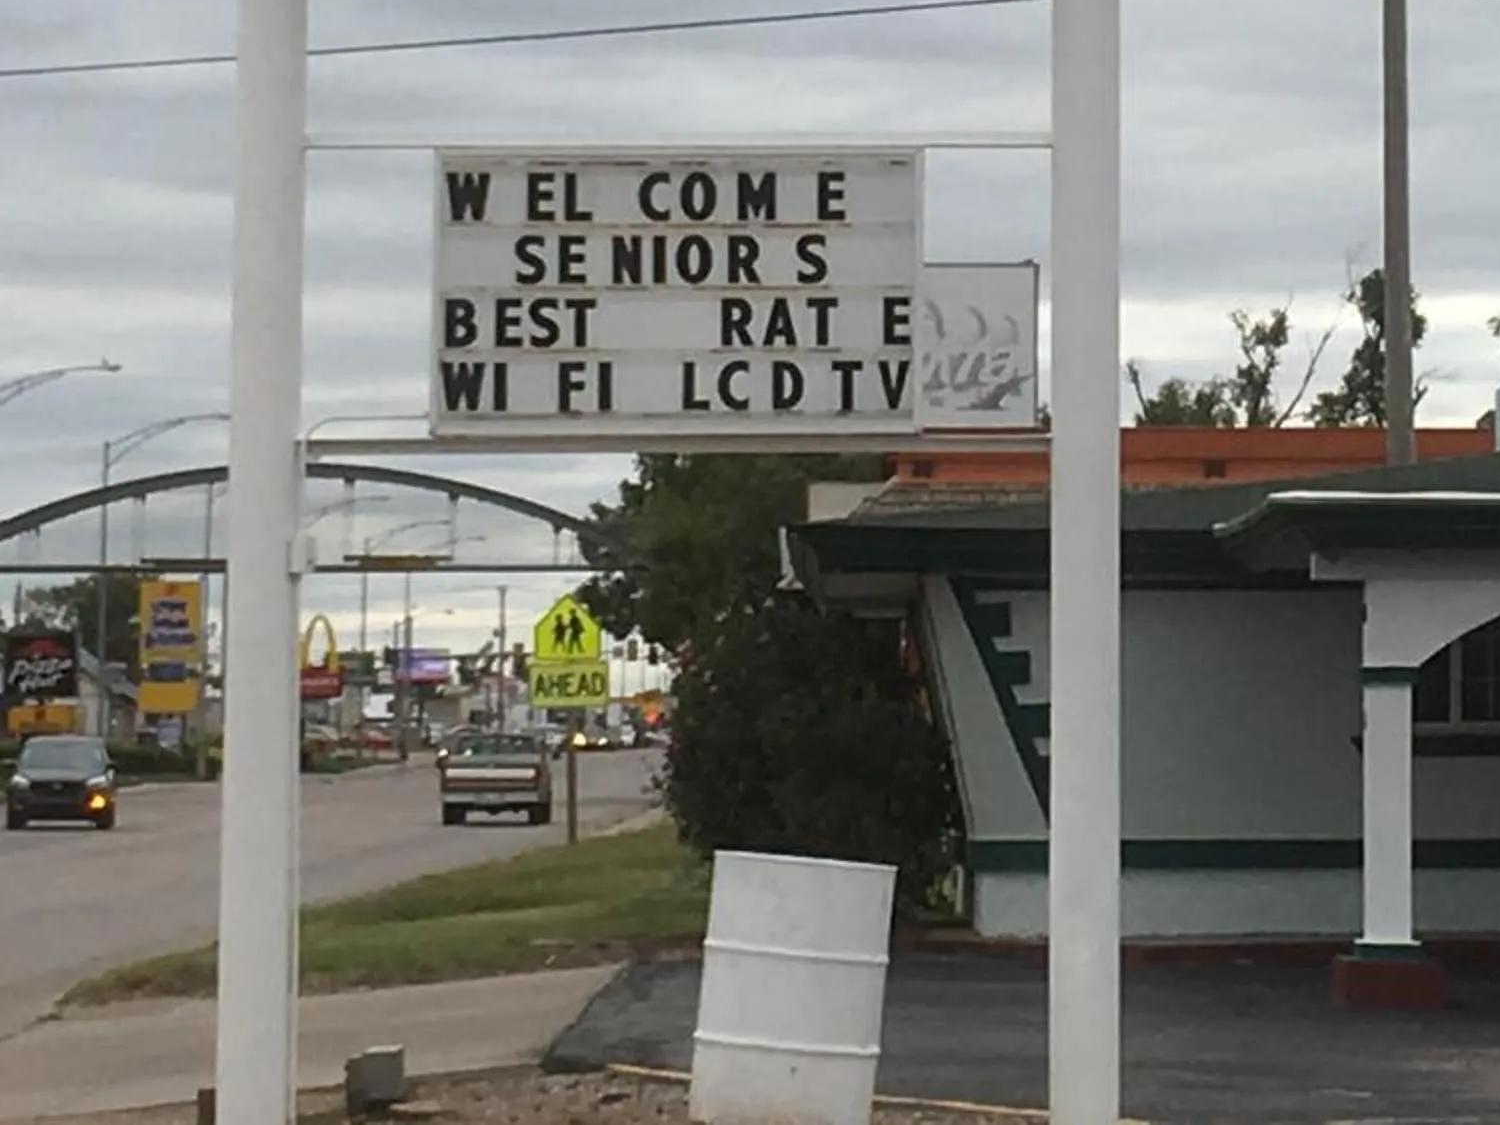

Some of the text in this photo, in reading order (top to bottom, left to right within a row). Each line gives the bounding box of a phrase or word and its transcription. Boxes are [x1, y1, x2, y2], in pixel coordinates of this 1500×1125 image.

[445, 170, 847, 222] WELCOME
[514, 233, 829, 285] SENIORS
[443, 296, 914, 348] BEST RATE
[533, 670, 605, 698] AHEAD
